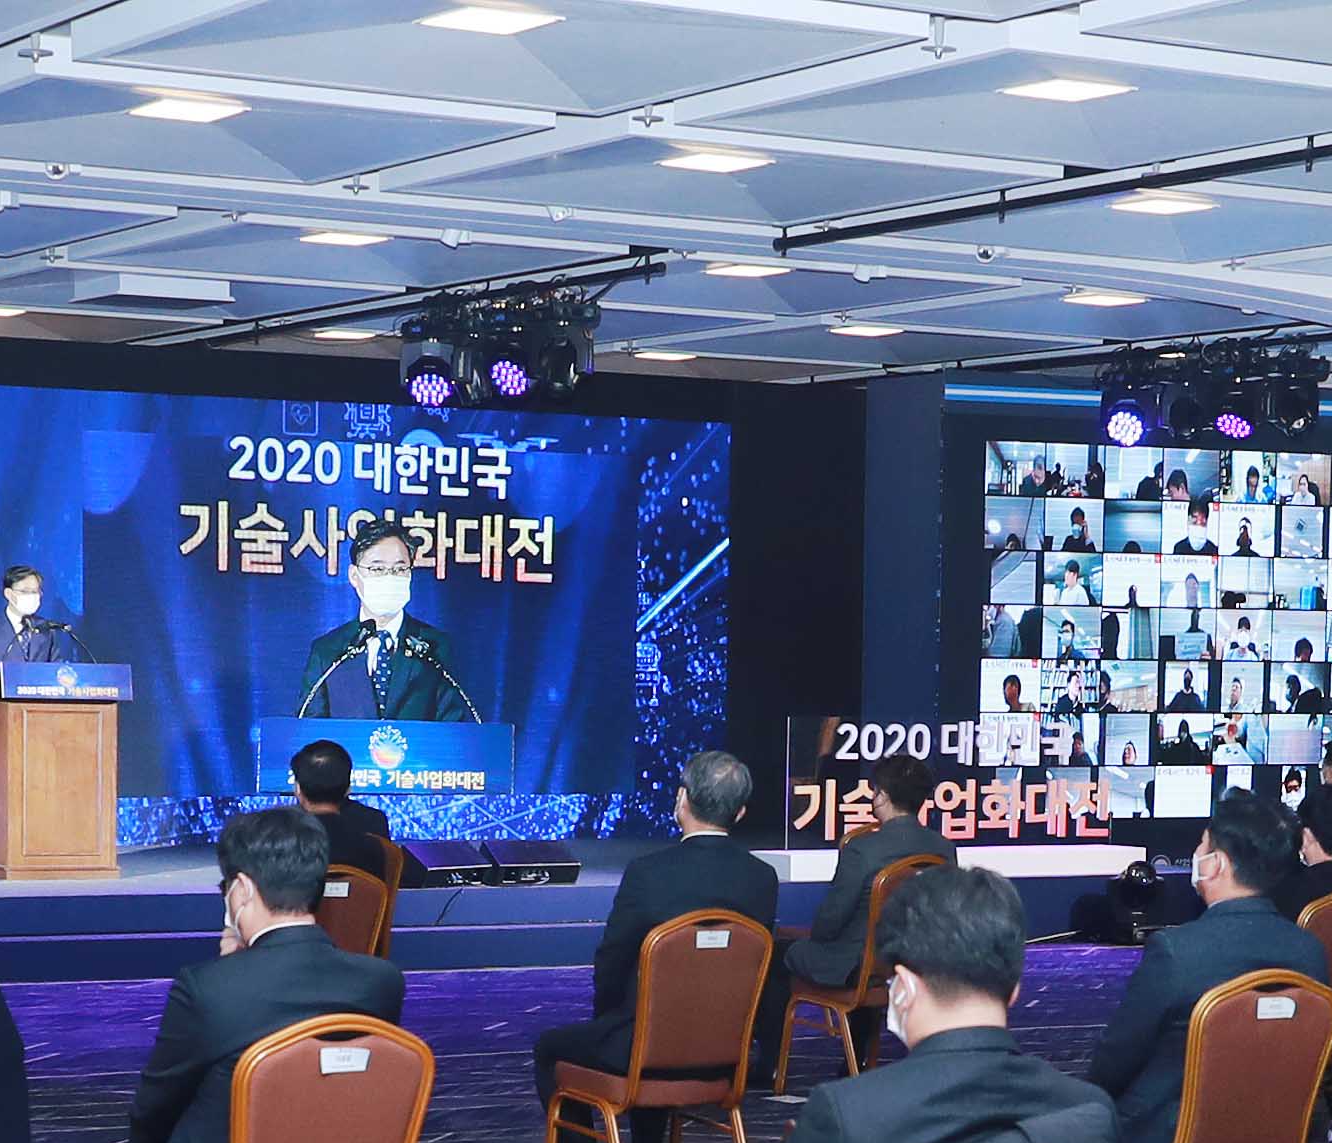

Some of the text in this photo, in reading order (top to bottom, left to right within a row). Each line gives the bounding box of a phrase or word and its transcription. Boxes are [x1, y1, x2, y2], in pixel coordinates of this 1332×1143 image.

[228, 436, 513, 500] 2020 대한민국
[834, 719, 1075, 767] 2020 대한민국
[386, 769, 485, 791] 기술사업화대전
[793, 778, 1111, 841] 기술업화대전
